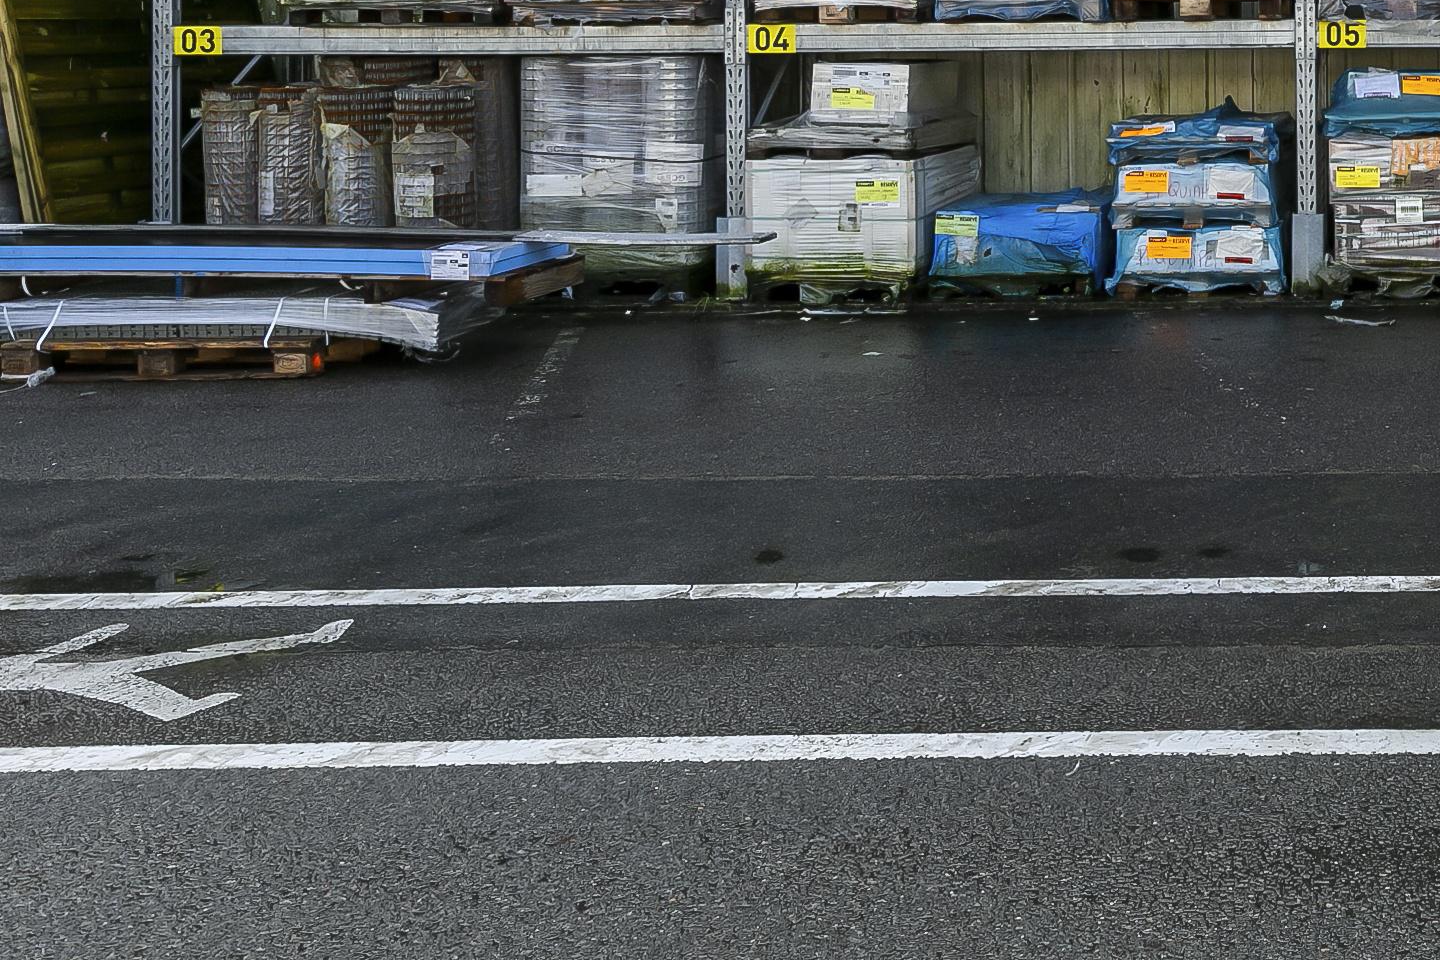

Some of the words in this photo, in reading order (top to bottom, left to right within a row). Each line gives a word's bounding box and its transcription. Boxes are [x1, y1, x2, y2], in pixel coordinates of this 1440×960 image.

[181, 28, 216, 53] 03
[755, 26, 790, 52] 04
[1326, 21, 1360, 47] 05
